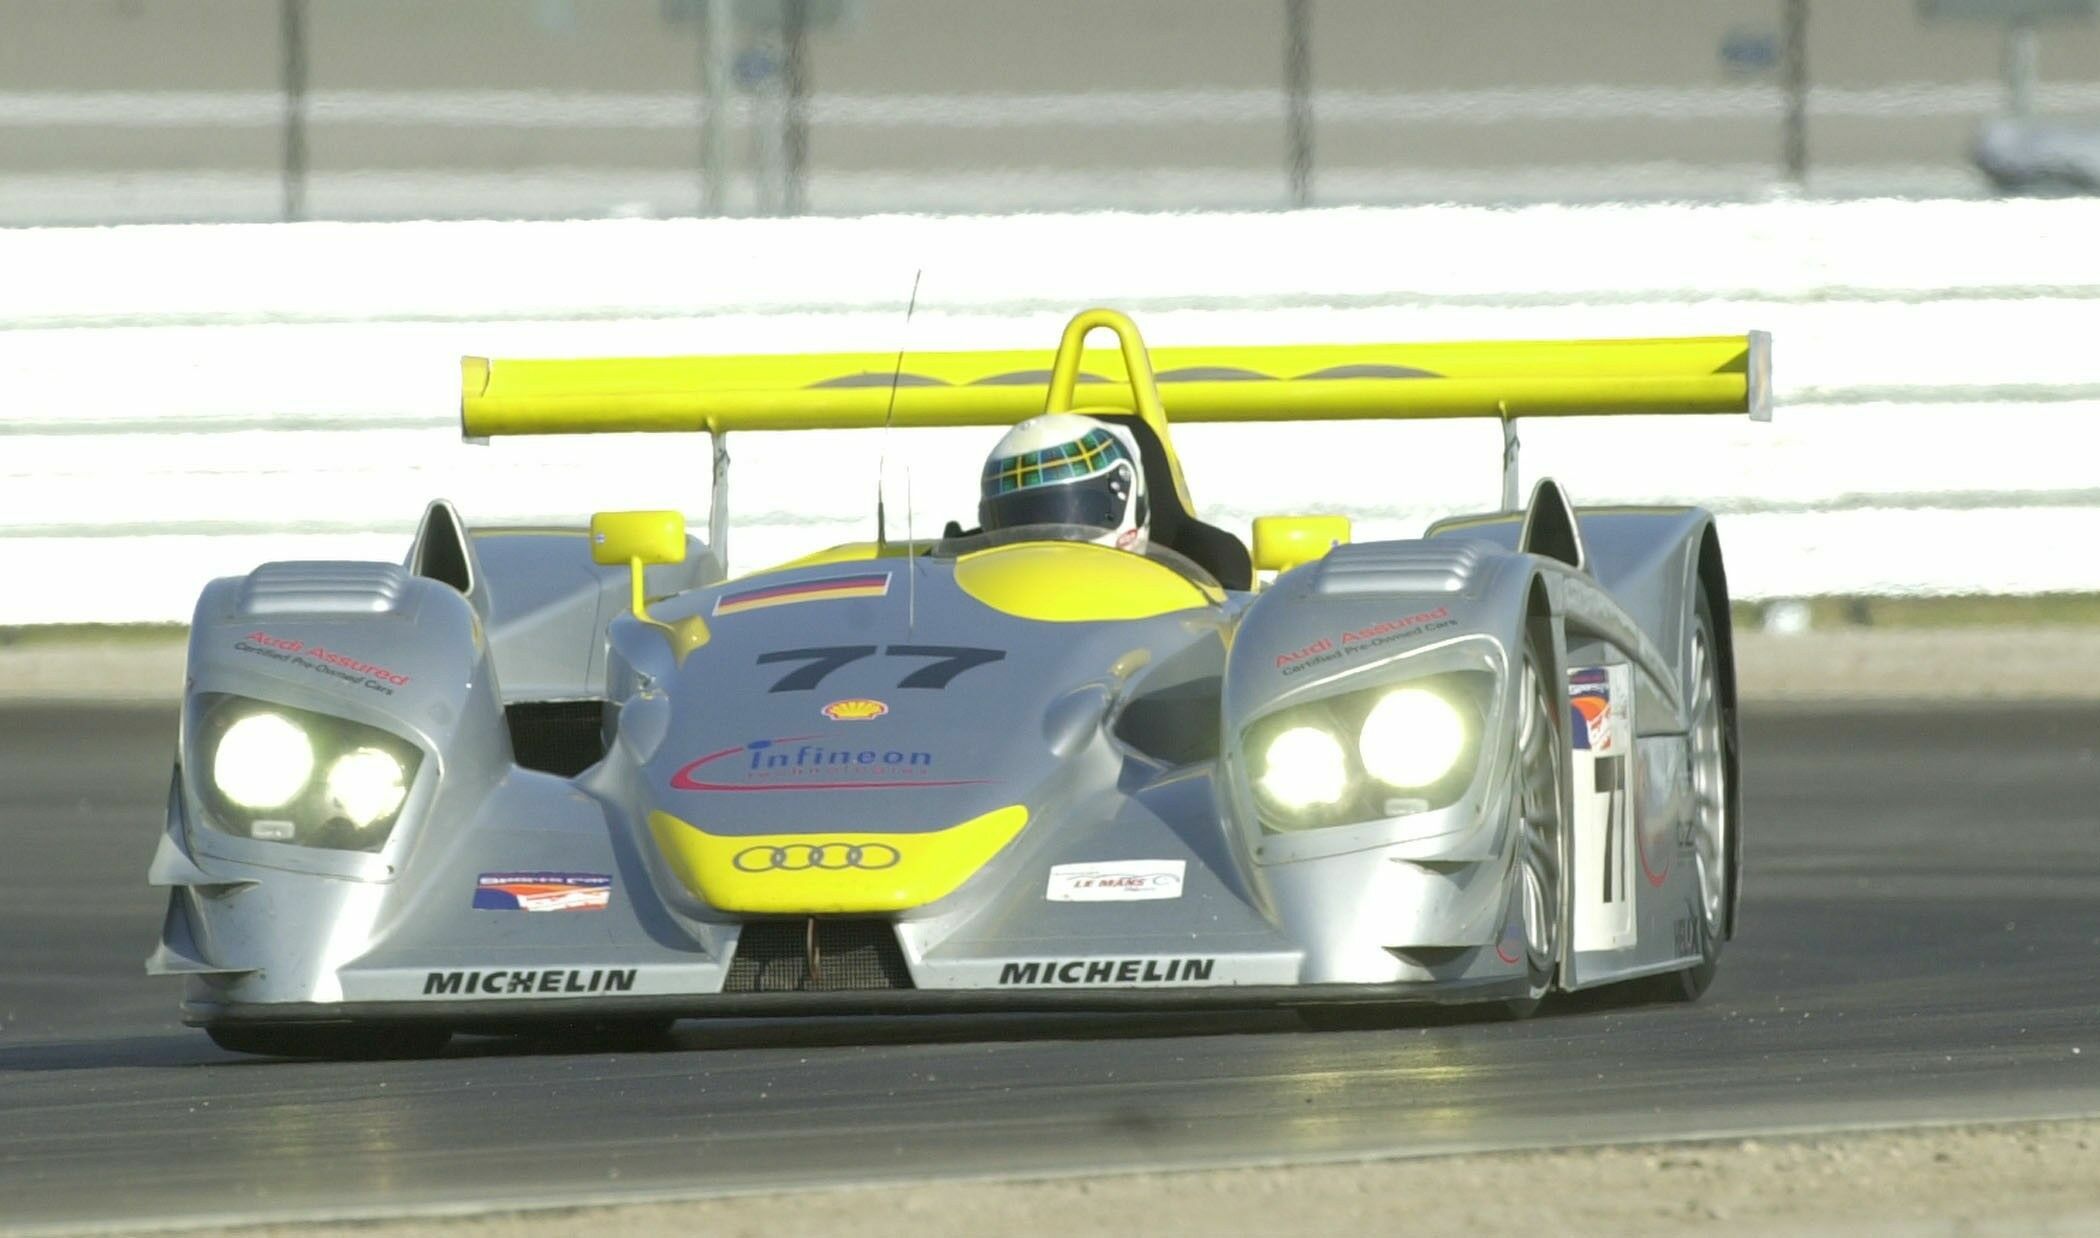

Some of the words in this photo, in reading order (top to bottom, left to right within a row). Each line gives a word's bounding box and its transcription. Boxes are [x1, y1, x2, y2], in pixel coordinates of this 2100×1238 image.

[1275, 637, 1333, 668] Audi
[1341, 606, 1449, 645] Assured
[1425, 617, 1459, 633] Cars
[244, 631, 304, 652] Audi
[307, 647, 410, 686] Assured
[756, 645, 1007, 693] 77
[365, 679, 394, 696] Cars
[747, 740, 932, 769] Infineon
[423, 968, 638, 994] MICHELIN
[998, 958, 1215, 984] MICHELIN
